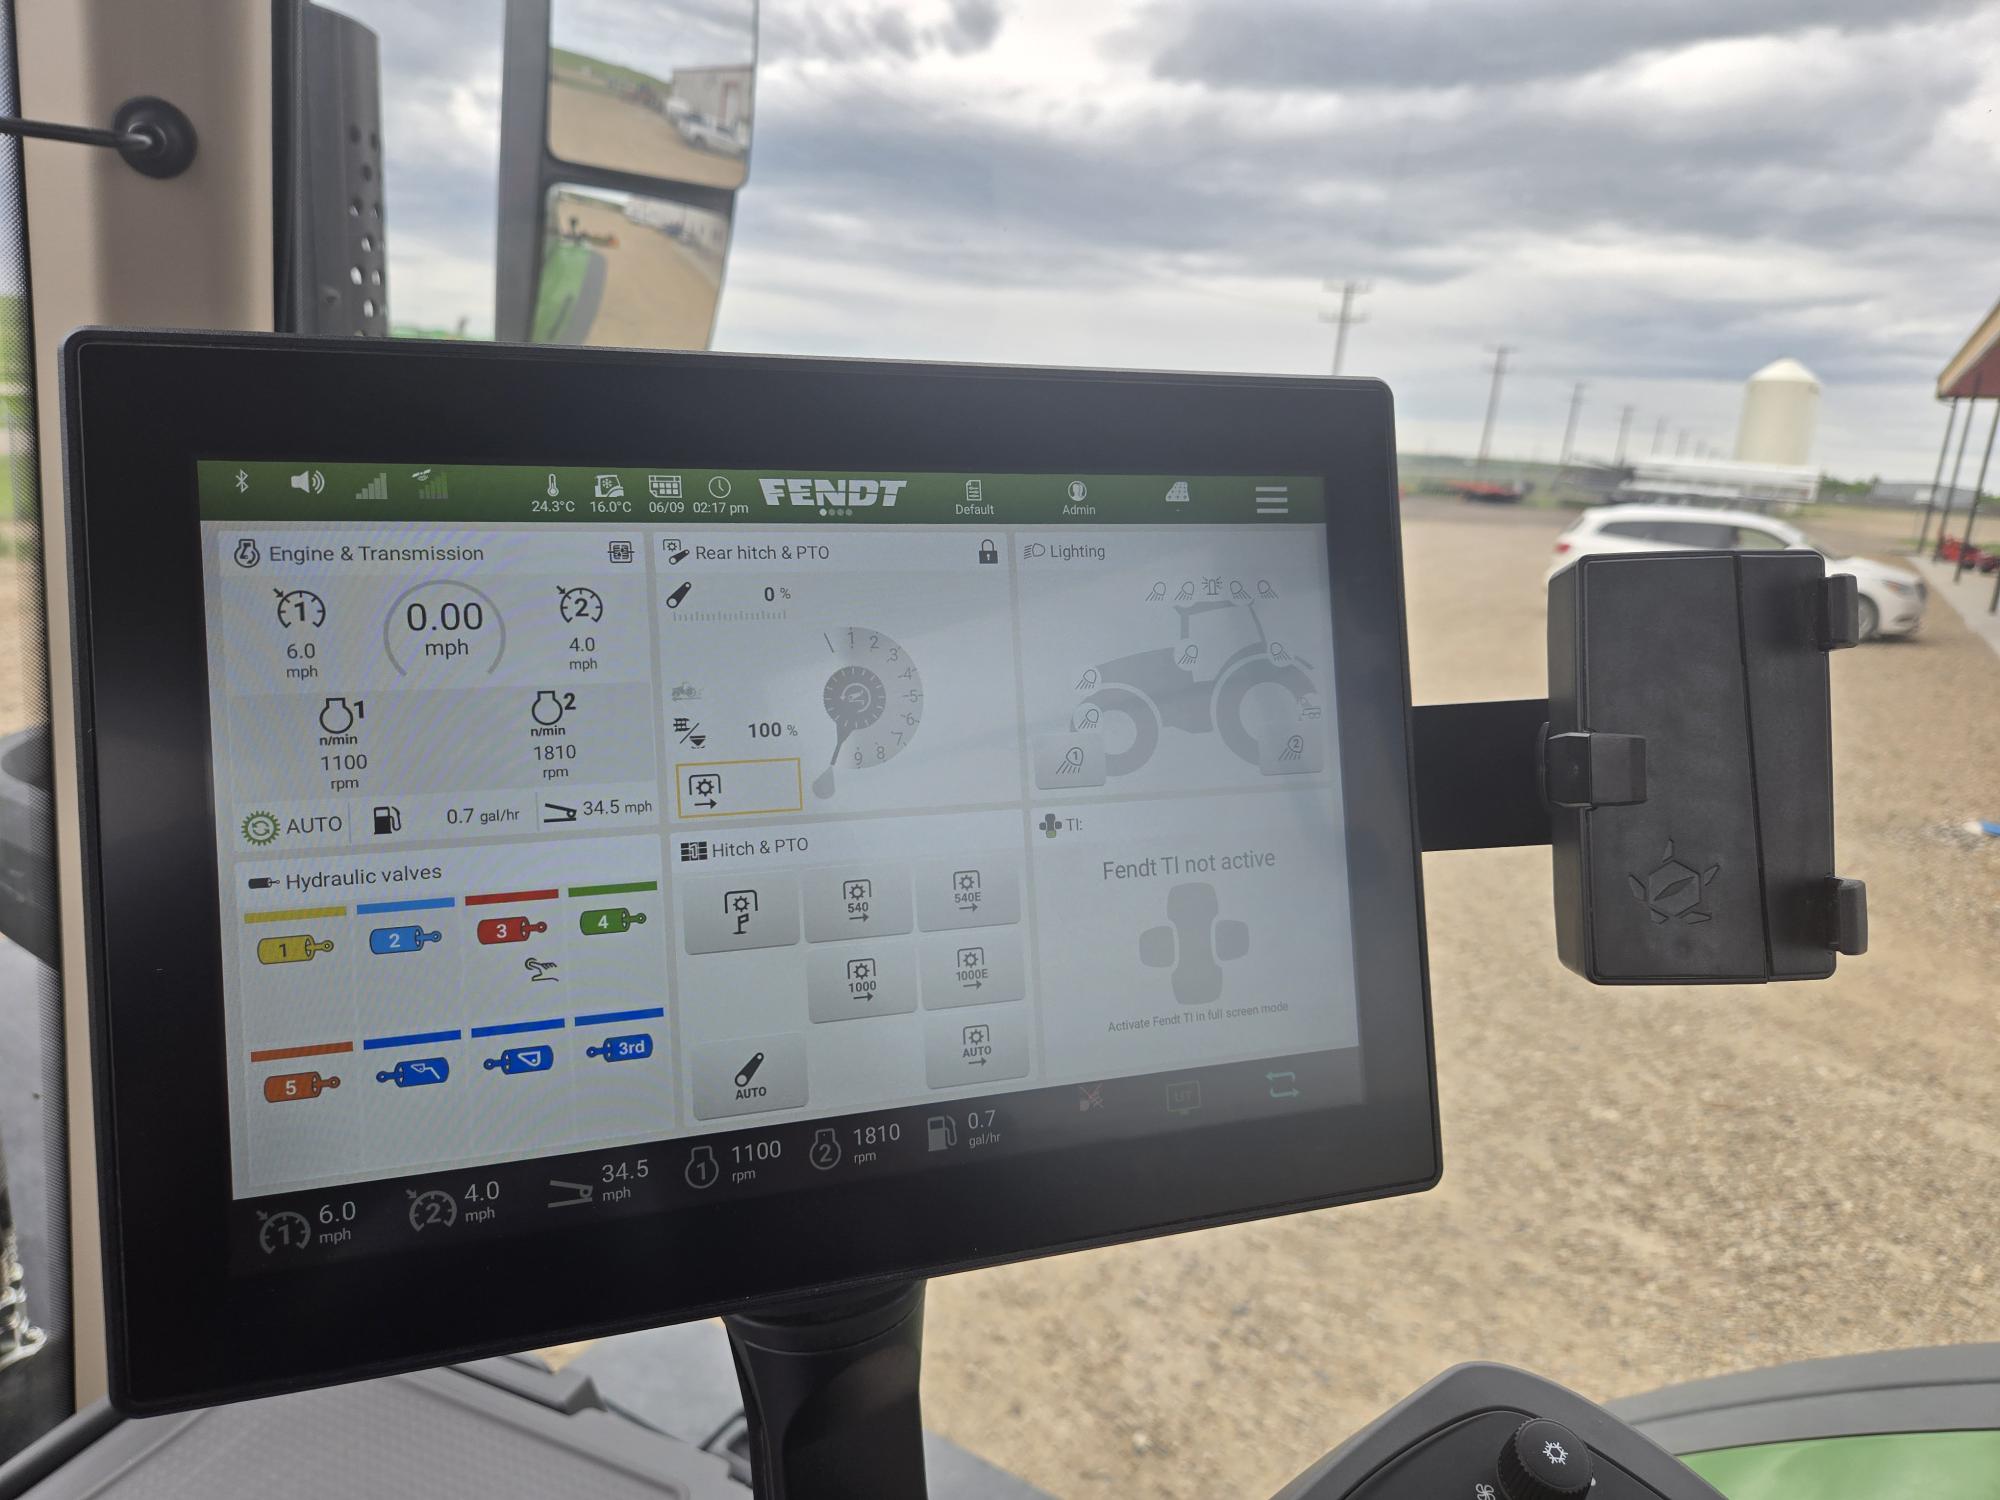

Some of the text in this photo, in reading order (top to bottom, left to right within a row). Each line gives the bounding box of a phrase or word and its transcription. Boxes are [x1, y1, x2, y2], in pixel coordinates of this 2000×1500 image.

[758, 478, 907, 507] FENDT
[532, 500, 576, 513] 24.3°C
[589, 500, 632, 513] 16.0°C
[648, 501, 685, 514] 06/09
[692, 502, 749, 516] 02:17 pm
[955, 503, 995, 516] Default
[1062, 503, 1096, 516] Admin
[269, 545, 484, 564] Engine & Transmission
[695, 544, 830, 560] Rear hitch & PTO
[1050, 544, 1105, 561] Lighting
[763, 586, 791, 602] 0 %
[296, 603, 306, 621] 1
[574, 599, 589, 617] 2
[406, 602, 483, 632] 0.00
[425, 639, 469, 659] mph
[569, 637, 596, 654] 4.0
[868, 635, 879, 649] 2
[286, 643, 316, 661] 6.0
[888, 648, 899, 662] 3
[286, 665, 318, 680] mph
[569, 658, 598, 672] mph
[563, 693, 576, 711] 2
[909, 689, 918, 703] 5
[353, 702, 365, 719] 1
[905, 713, 915, 726] 6
[530, 725, 566, 737] n/min
[748, 722, 798, 739] 100 %
[319, 733, 358, 746] n/min
[534, 744, 577, 762] 1810
[854, 751, 863, 766] 9
[876, 746, 886, 761] 8
[320, 754, 368, 771] 1100
[542, 766, 569, 780] rpm
[330, 777, 359, 792] rpm
[583, 800, 653, 816] 34.5 mph
[446, 808, 520, 825] 0.7 gal/hr
[286, 816, 342, 835] AUTO
[712, 837, 809, 859] Hitch & PTO
[1103, 859, 1157, 880] Fendt
[1185, 854, 1216, 874] not
[1221, 850, 1276, 871] active
[285, 865, 442, 893] Hydraulic valves
[954, 892, 982, 903] 540E
[847, 901, 869, 913] 540
[597, 914, 609, 929] 4
[496, 923, 507, 939] 3
[388, 934, 401, 949] 2
[278, 943, 287, 958] 1
[955, 969, 988, 981] 1000E
[848, 981, 877, 993] 1000
[1107, 1018, 1150, 1033] Activate
[1153, 1015, 1181, 1027] Fendt
[1196, 1012, 1205, 1022] in
[1207, 1009, 1223, 1021] full
[1226, 1007, 1260, 1019] screen
[1261, 1001, 1288, 1015] mode
[619, 1039, 645, 1056] 3rd
[962, 1045, 992, 1058] AUTO
[285, 1080, 296, 1096] 5
[735, 1086, 767, 1100] AUTO
[967, 1110, 996, 1130] 0.7
[853, 1123, 900, 1146] 1810
[969, 1132, 1001, 1148] gal/hr
[731, 1141, 782, 1164] 1100
[819, 1144, 831, 1163] 2
[854, 1151, 877, 1166] rpm
[601, 1160, 649, 1183] 34.5
[697, 1162, 706, 1180] 1
[731, 1168, 756, 1184] rpm
[464, 1181, 500, 1202] 4.0
[602, 1187, 632, 1203] mph
[318, 1202, 356, 1225] 6.0
[426, 1203, 441, 1223] 2
[465, 1207, 496, 1223] mph
[278, 1225, 292, 1245] 1
[319, 1228, 352, 1245] mph
